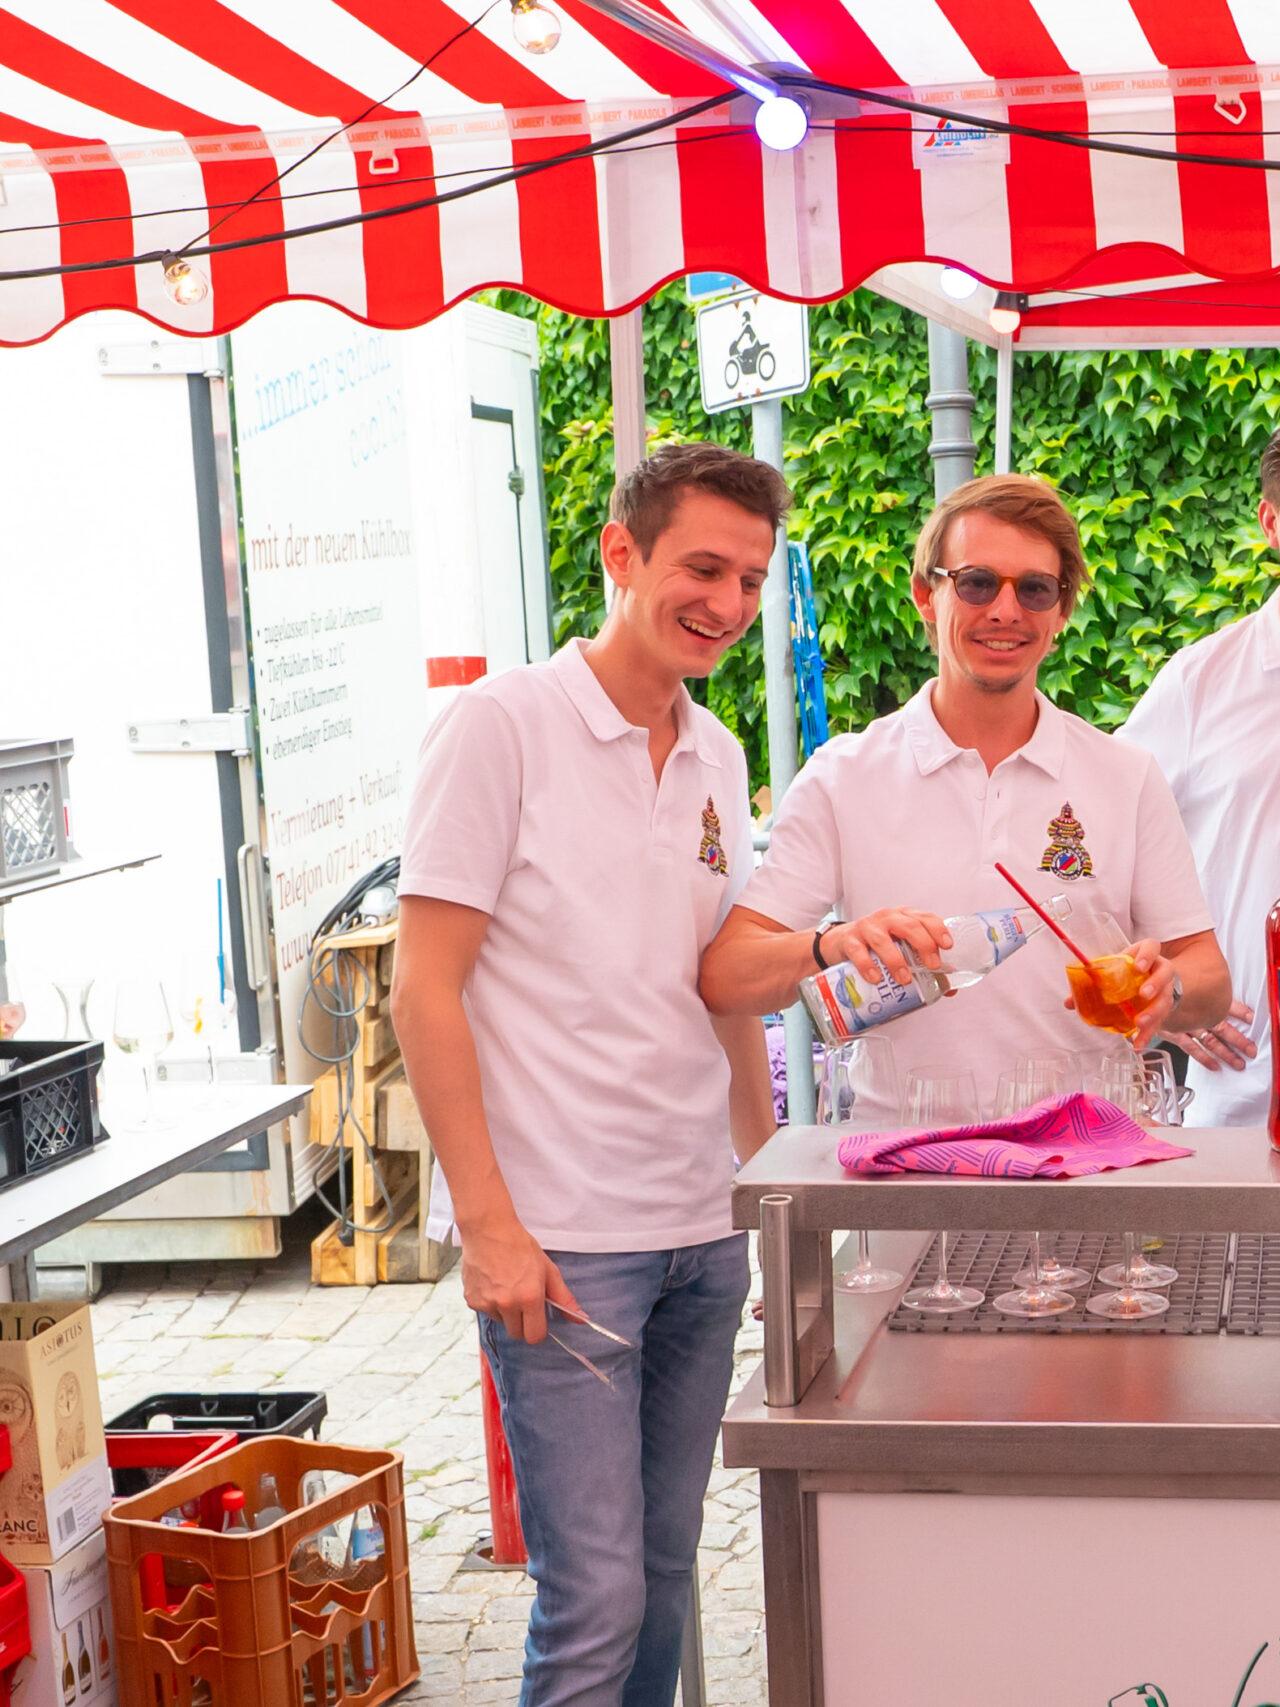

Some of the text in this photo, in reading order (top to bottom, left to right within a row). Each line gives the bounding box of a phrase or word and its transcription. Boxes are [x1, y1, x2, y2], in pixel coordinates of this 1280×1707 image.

[251, 522, 280, 572] mit
[284, 522, 310, 568] der
[314, 532, 358, 565] neuen
[270, 794, 344, 848] Vermietung
[276, 859, 323, 911] Telefon
[40, 1320, 84, 1358] ASIOTUS
